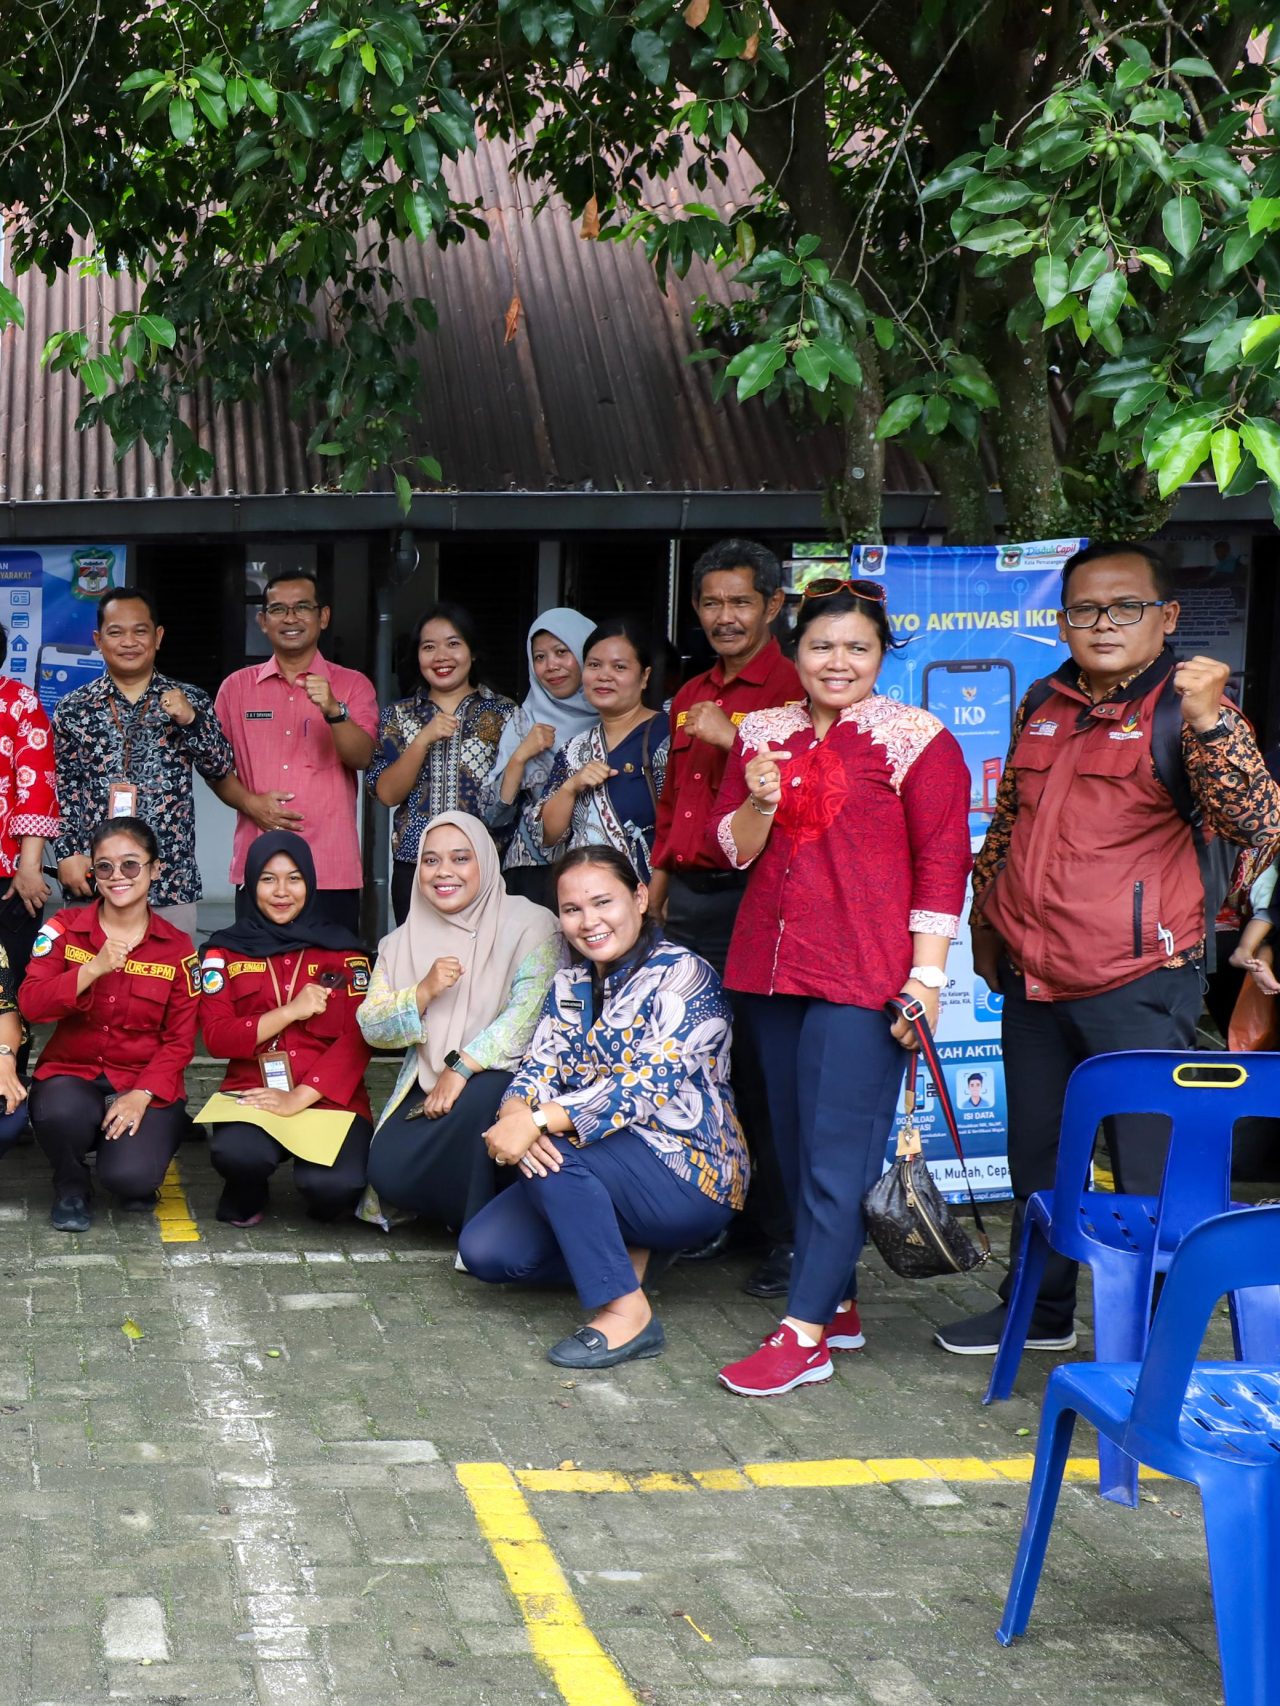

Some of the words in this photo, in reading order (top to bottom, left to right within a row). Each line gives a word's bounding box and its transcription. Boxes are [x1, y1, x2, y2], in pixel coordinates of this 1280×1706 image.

[926, 611, 1019, 631] AKTIVASI
[954, 706, 986, 725] IKD
[129, 963, 149, 974] URC
[150, 966, 172, 978] SPM
[964, 1112, 974, 1120] ISI
[975, 1111, 995, 1119] DATA
[945, 1165, 984, 1179] Mudah,
